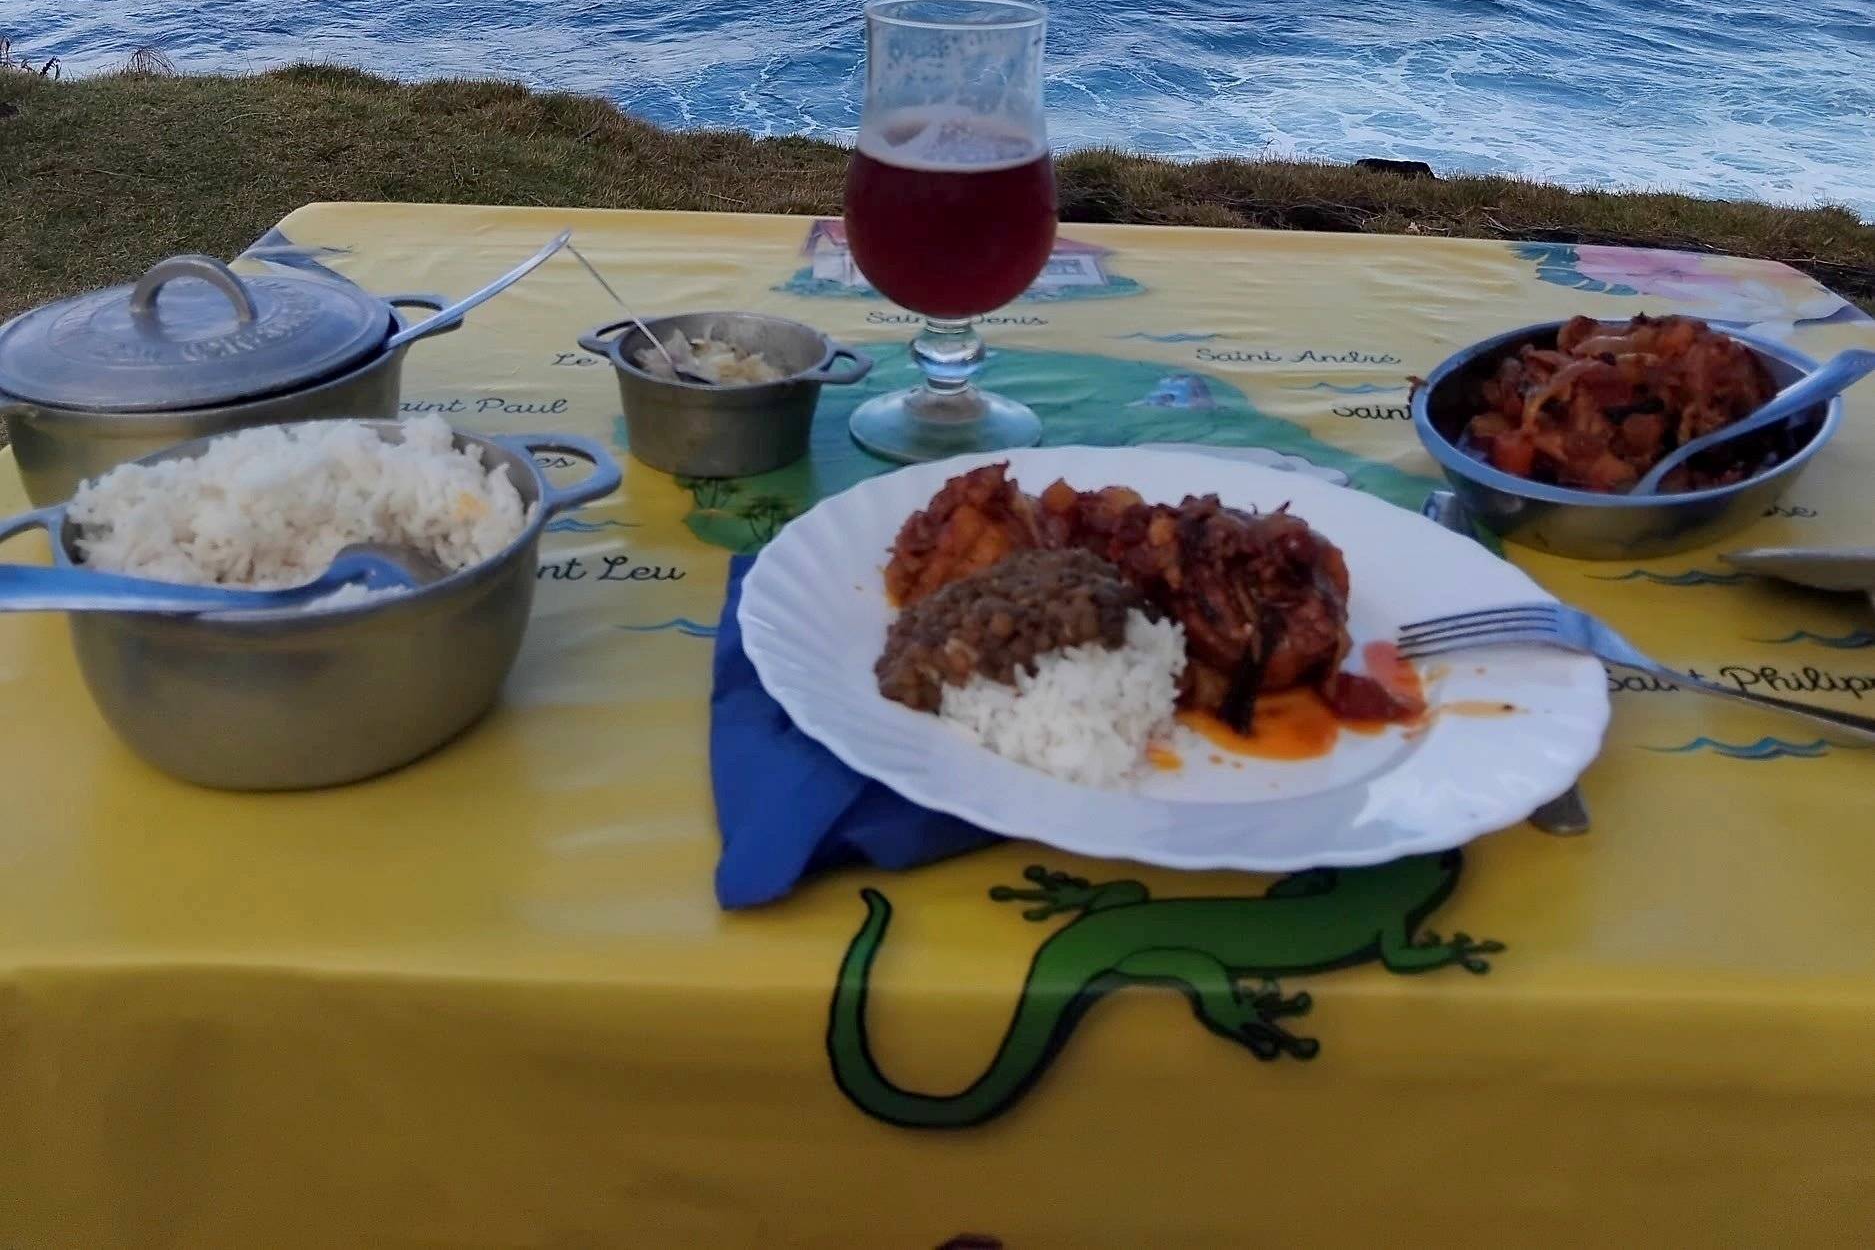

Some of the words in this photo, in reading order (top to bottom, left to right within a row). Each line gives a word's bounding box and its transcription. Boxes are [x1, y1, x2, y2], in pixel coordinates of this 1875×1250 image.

[550, 352, 598, 367] Le
[1196, 348, 1283, 363] Saint
[401, 399, 467, 414] aint
[475, 397, 568, 415] Paul
[596, 555, 687, 582] Leu
[1719, 666, 1875, 700] Philip
